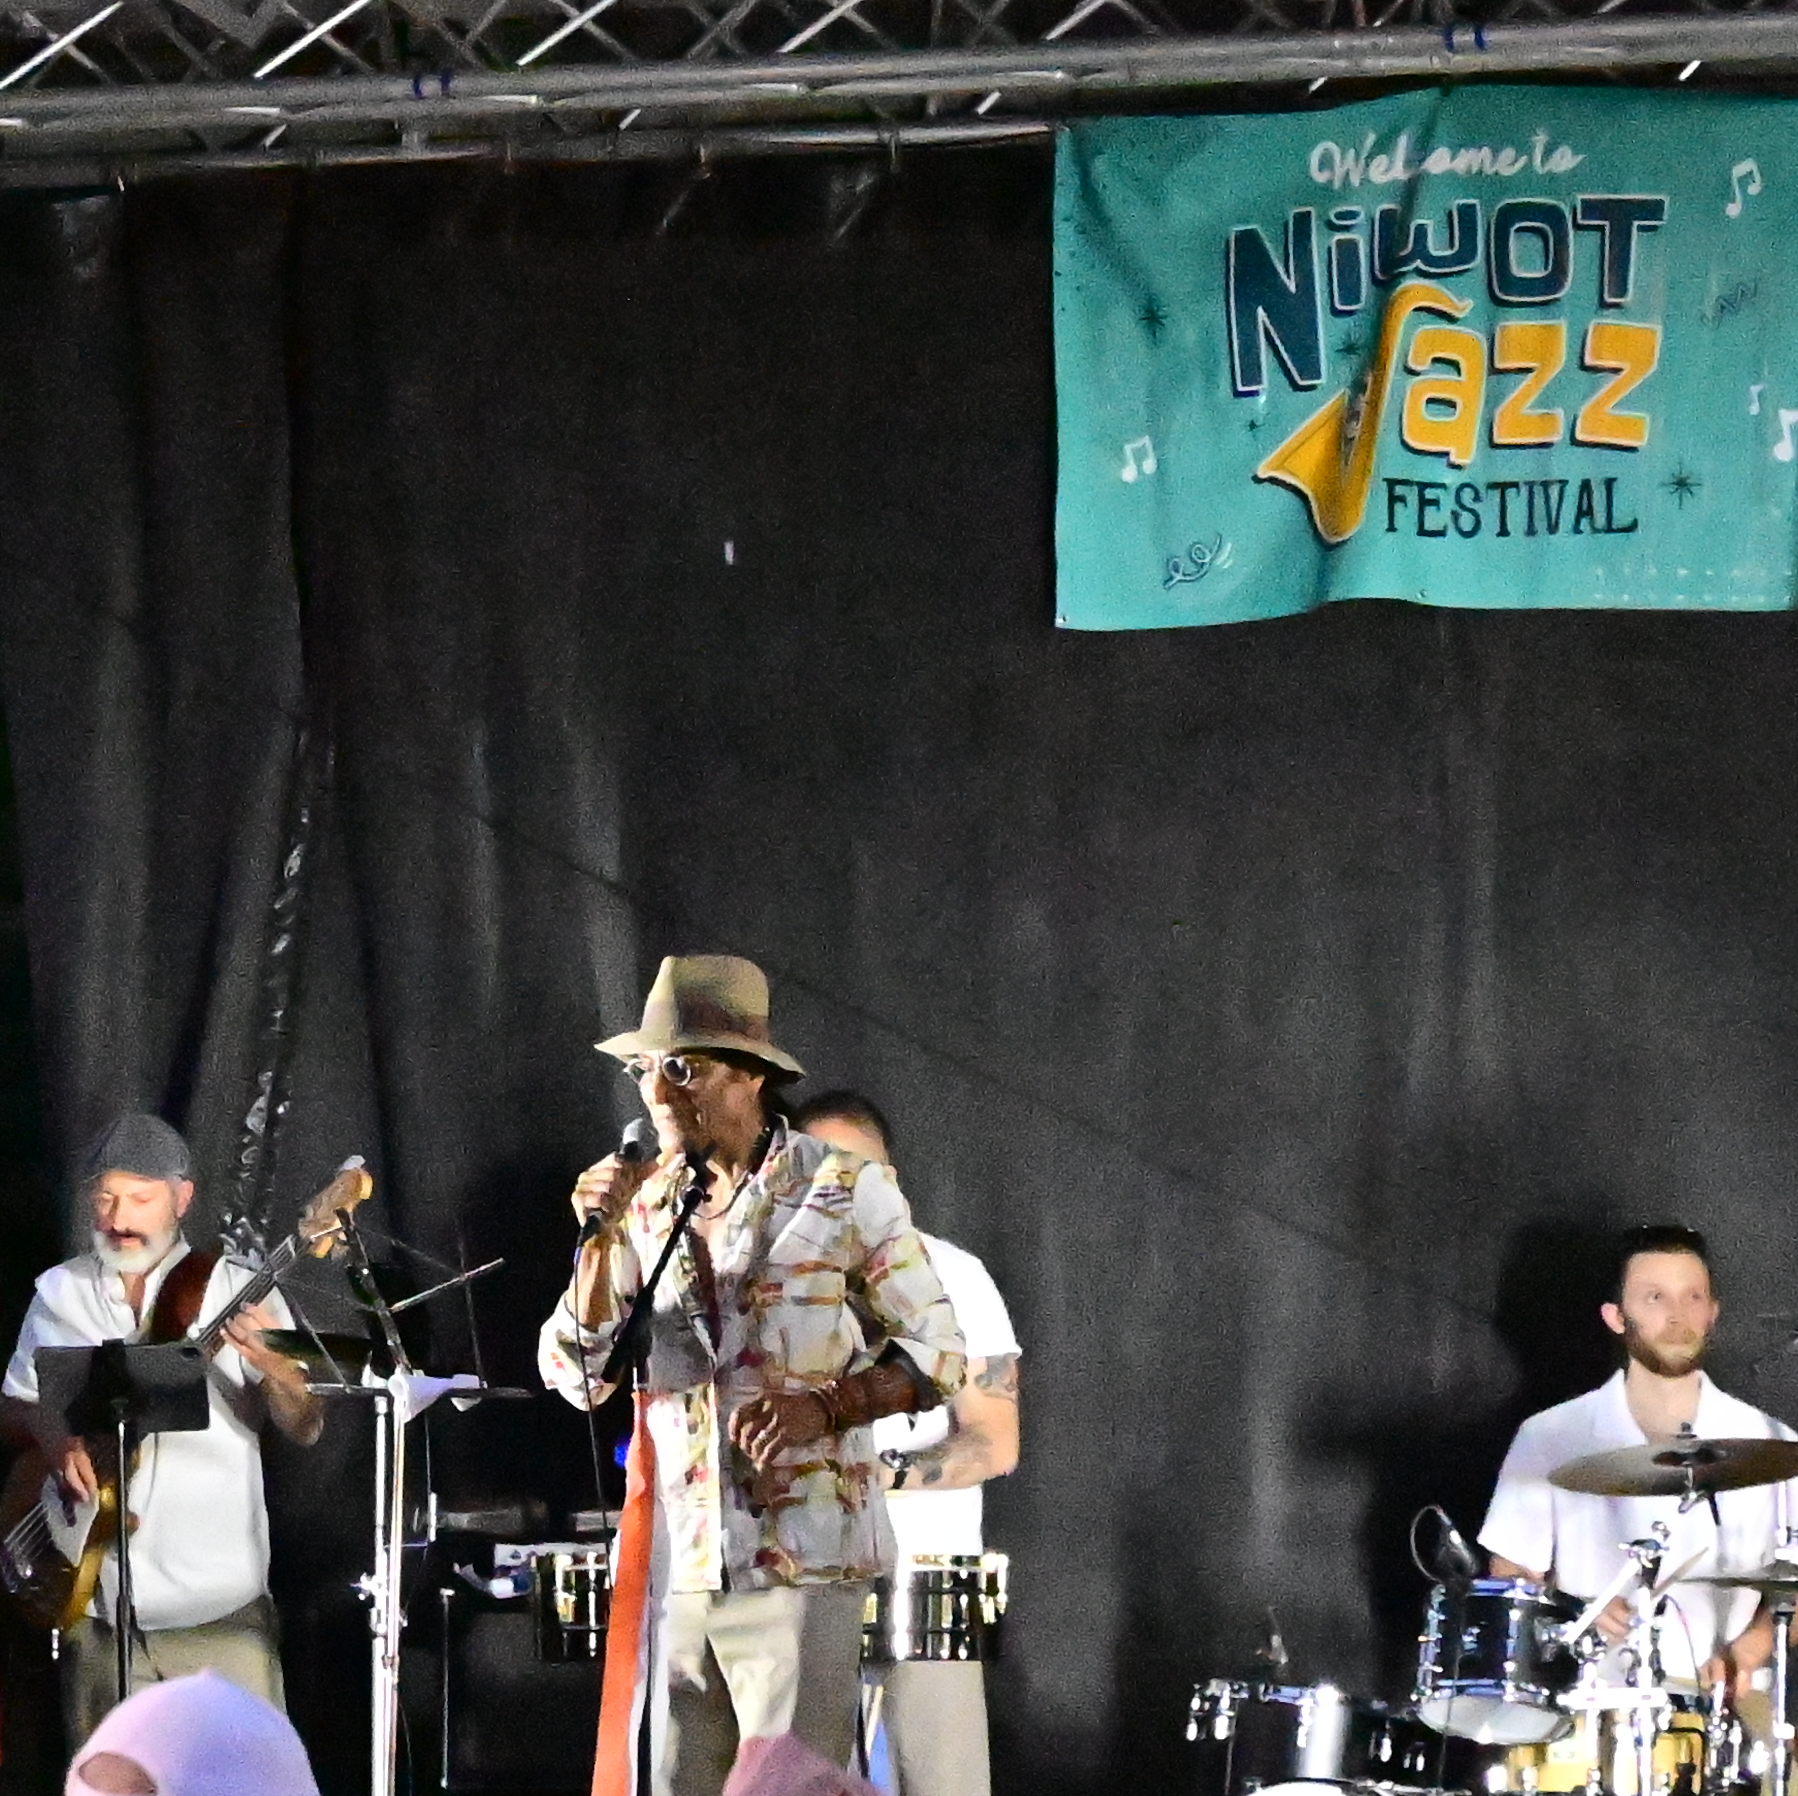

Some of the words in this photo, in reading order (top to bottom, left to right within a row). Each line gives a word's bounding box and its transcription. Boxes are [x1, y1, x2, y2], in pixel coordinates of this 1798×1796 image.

[1309, 131, 1528, 189] Welome
[1531, 127, 1587, 175] to
[1382, 477, 1639, 539] FESTIVAL
